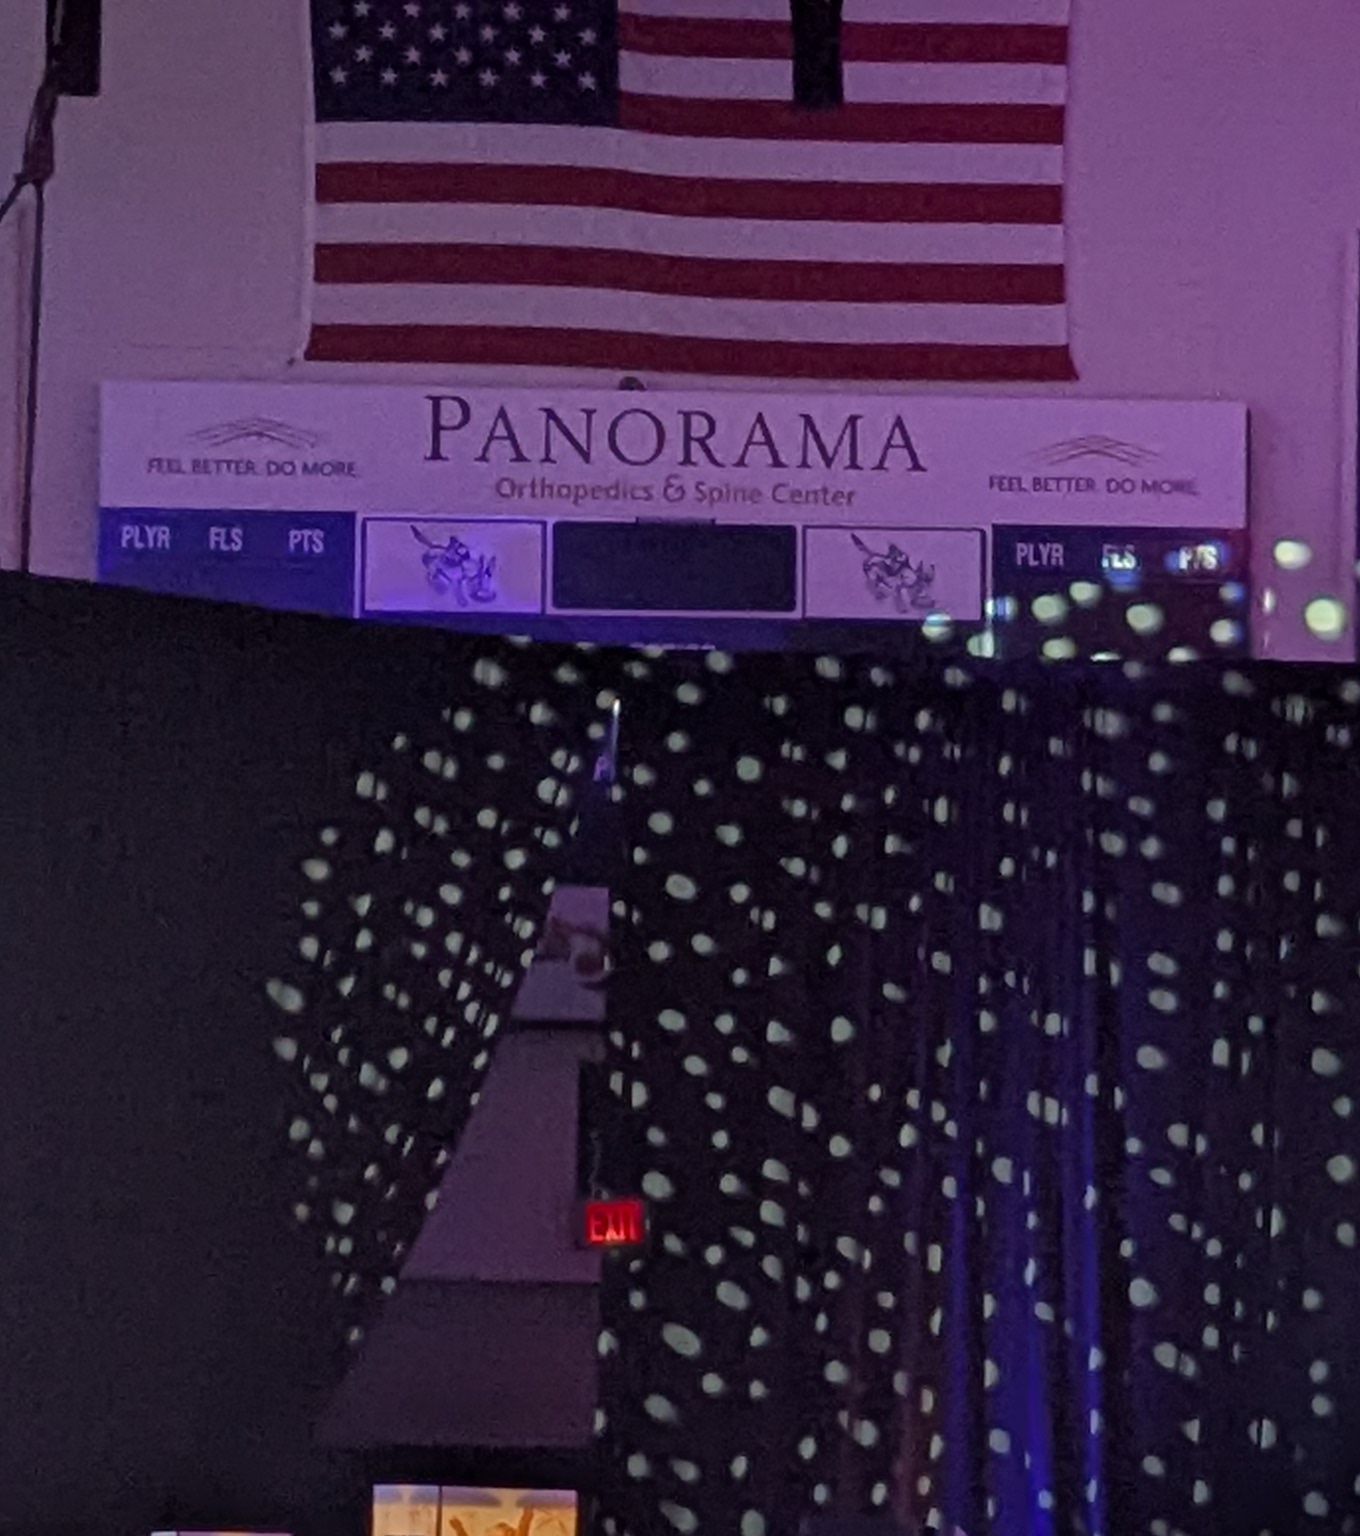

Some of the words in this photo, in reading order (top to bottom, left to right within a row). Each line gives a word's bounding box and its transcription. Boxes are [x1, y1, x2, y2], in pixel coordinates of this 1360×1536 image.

[424, 394, 928, 473] PANORAMA
[147, 457, 186, 475] FEEL
[266, 461, 296, 477] DO
[495, 477, 654, 504] Orthopedics
[662, 473, 685, 503] &
[694, 480, 763, 507] Spine
[771, 482, 857, 508] Center
[989, 475, 1028, 492] FEEL
[1106, 478, 1136, 495] DO
[121, 525, 171, 549] PLYR
[209, 527, 243, 551] FLS
[288, 529, 324, 553] PTS
[1016, 543, 1064, 566] PLYR
